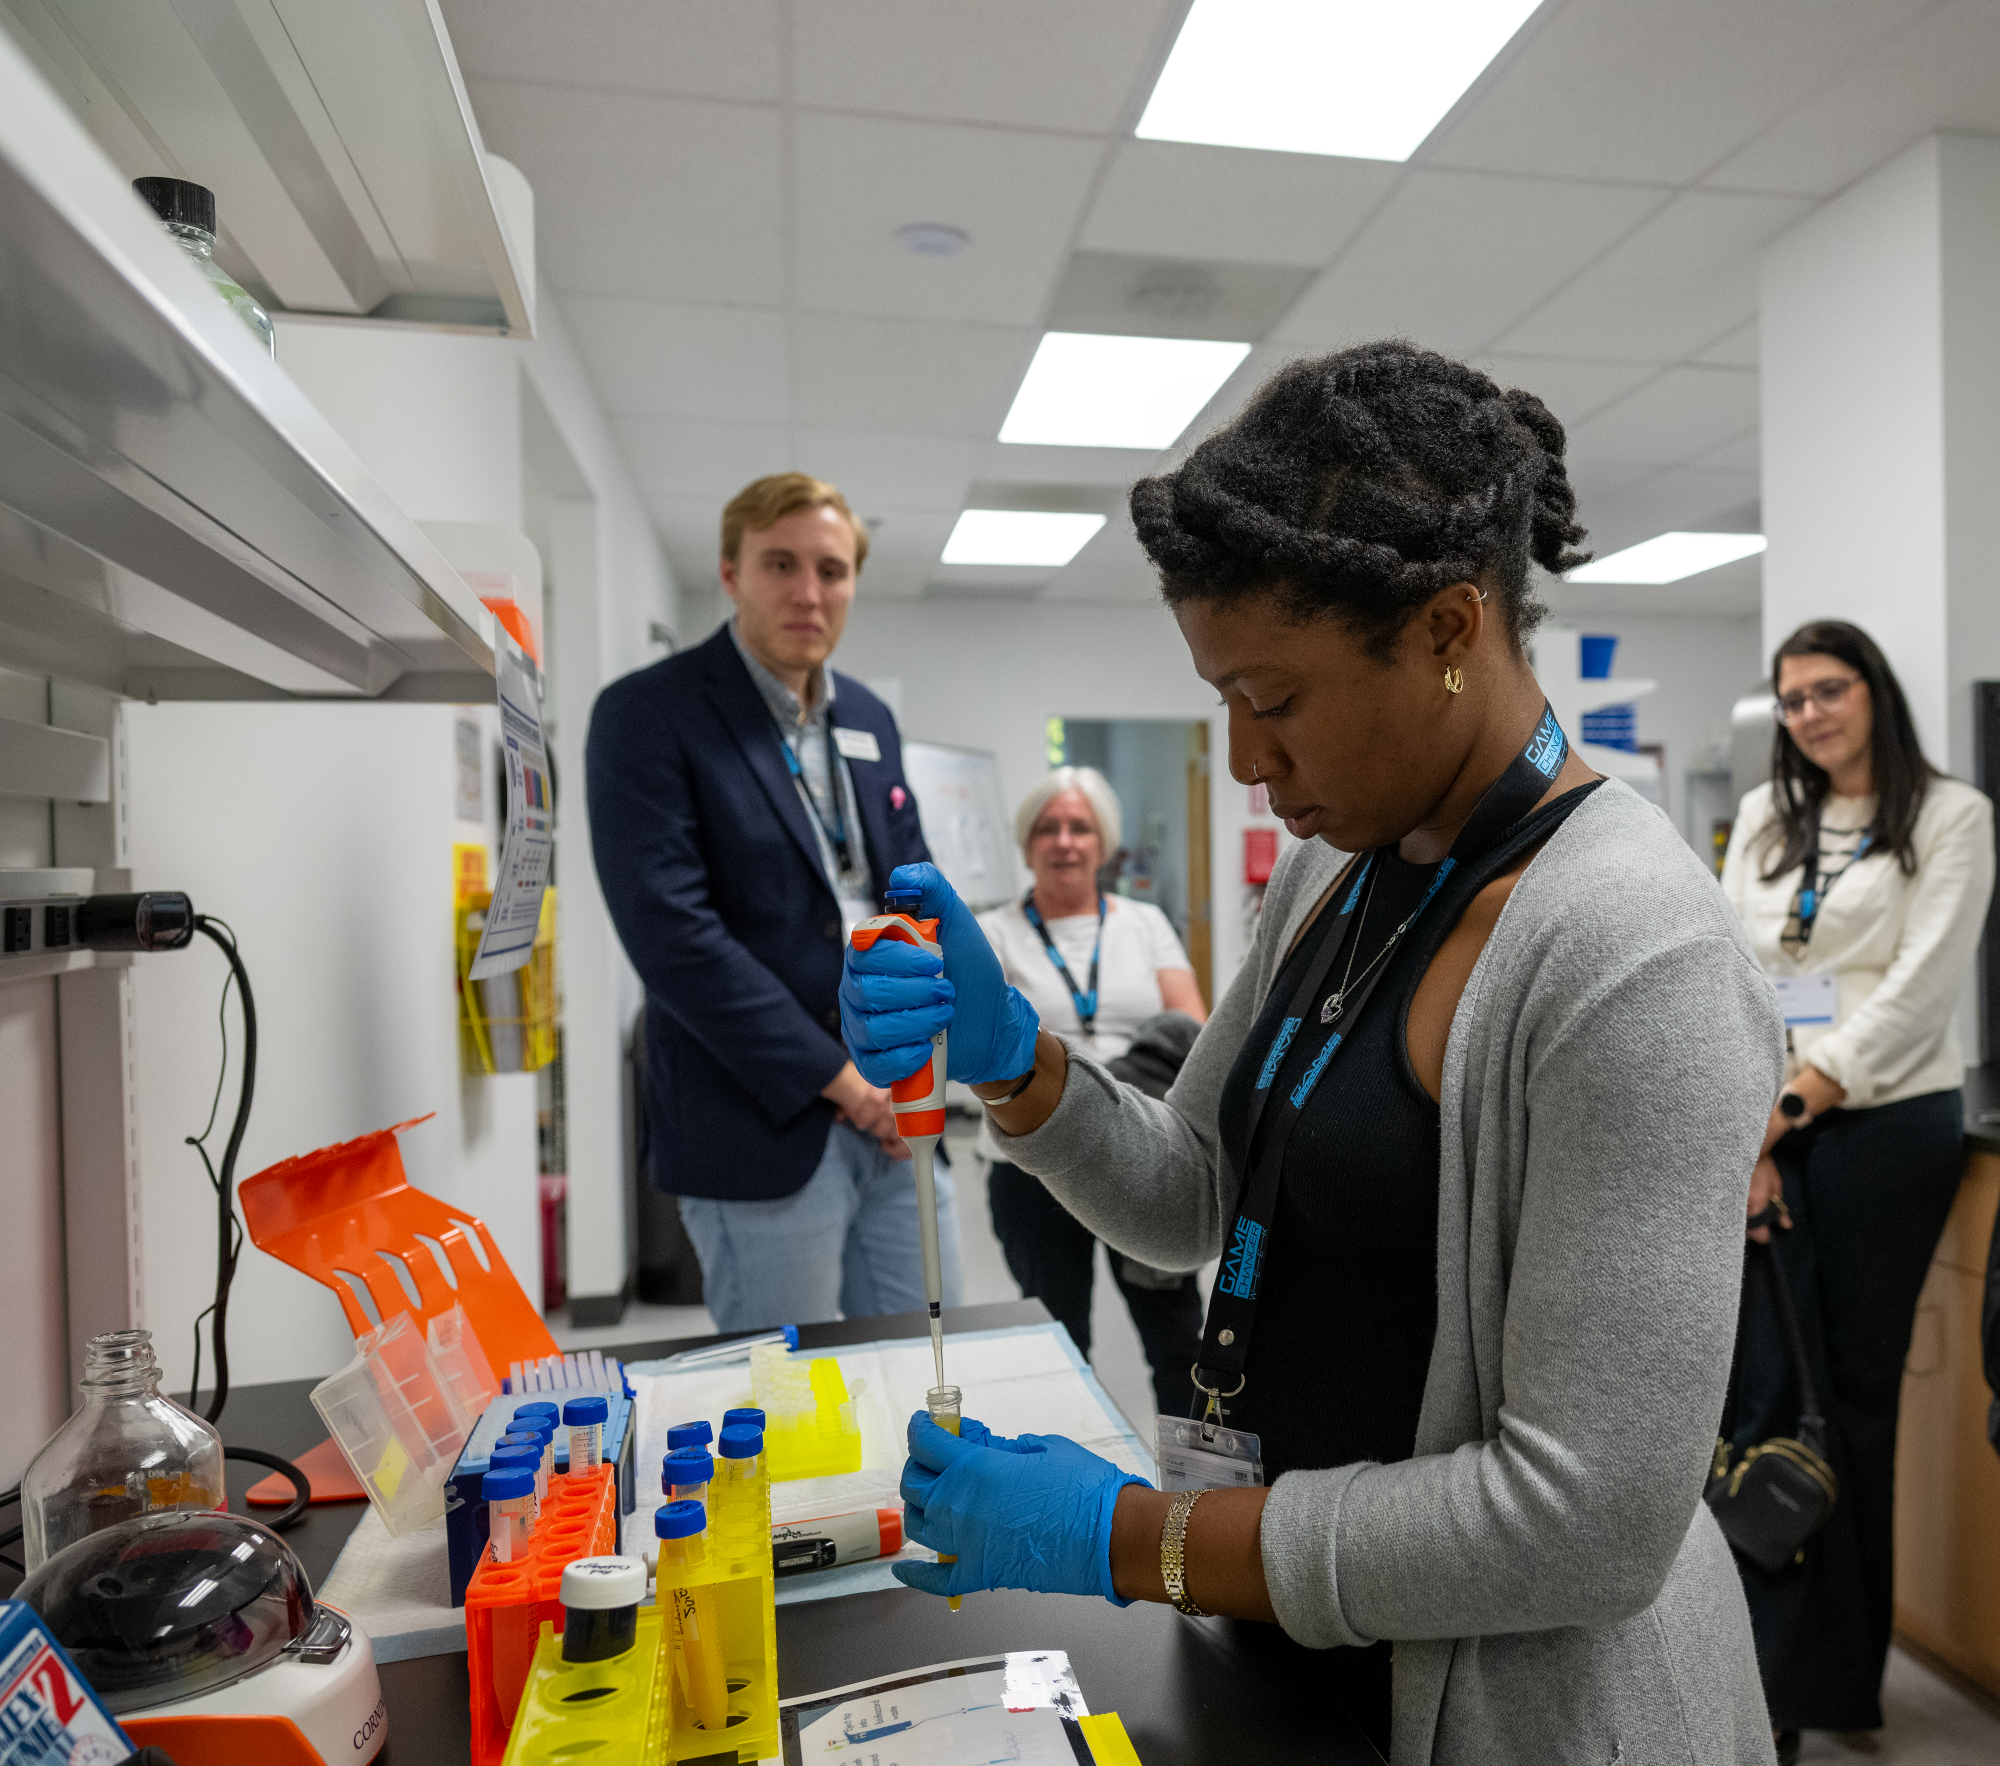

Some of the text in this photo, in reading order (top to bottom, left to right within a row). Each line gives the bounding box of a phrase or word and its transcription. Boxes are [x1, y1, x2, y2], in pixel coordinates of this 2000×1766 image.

[1525, 709, 1555, 764] GAME
[1219, 1215, 1251, 1294] GAME
[1237, 1224, 1260, 1296] CHANGER
